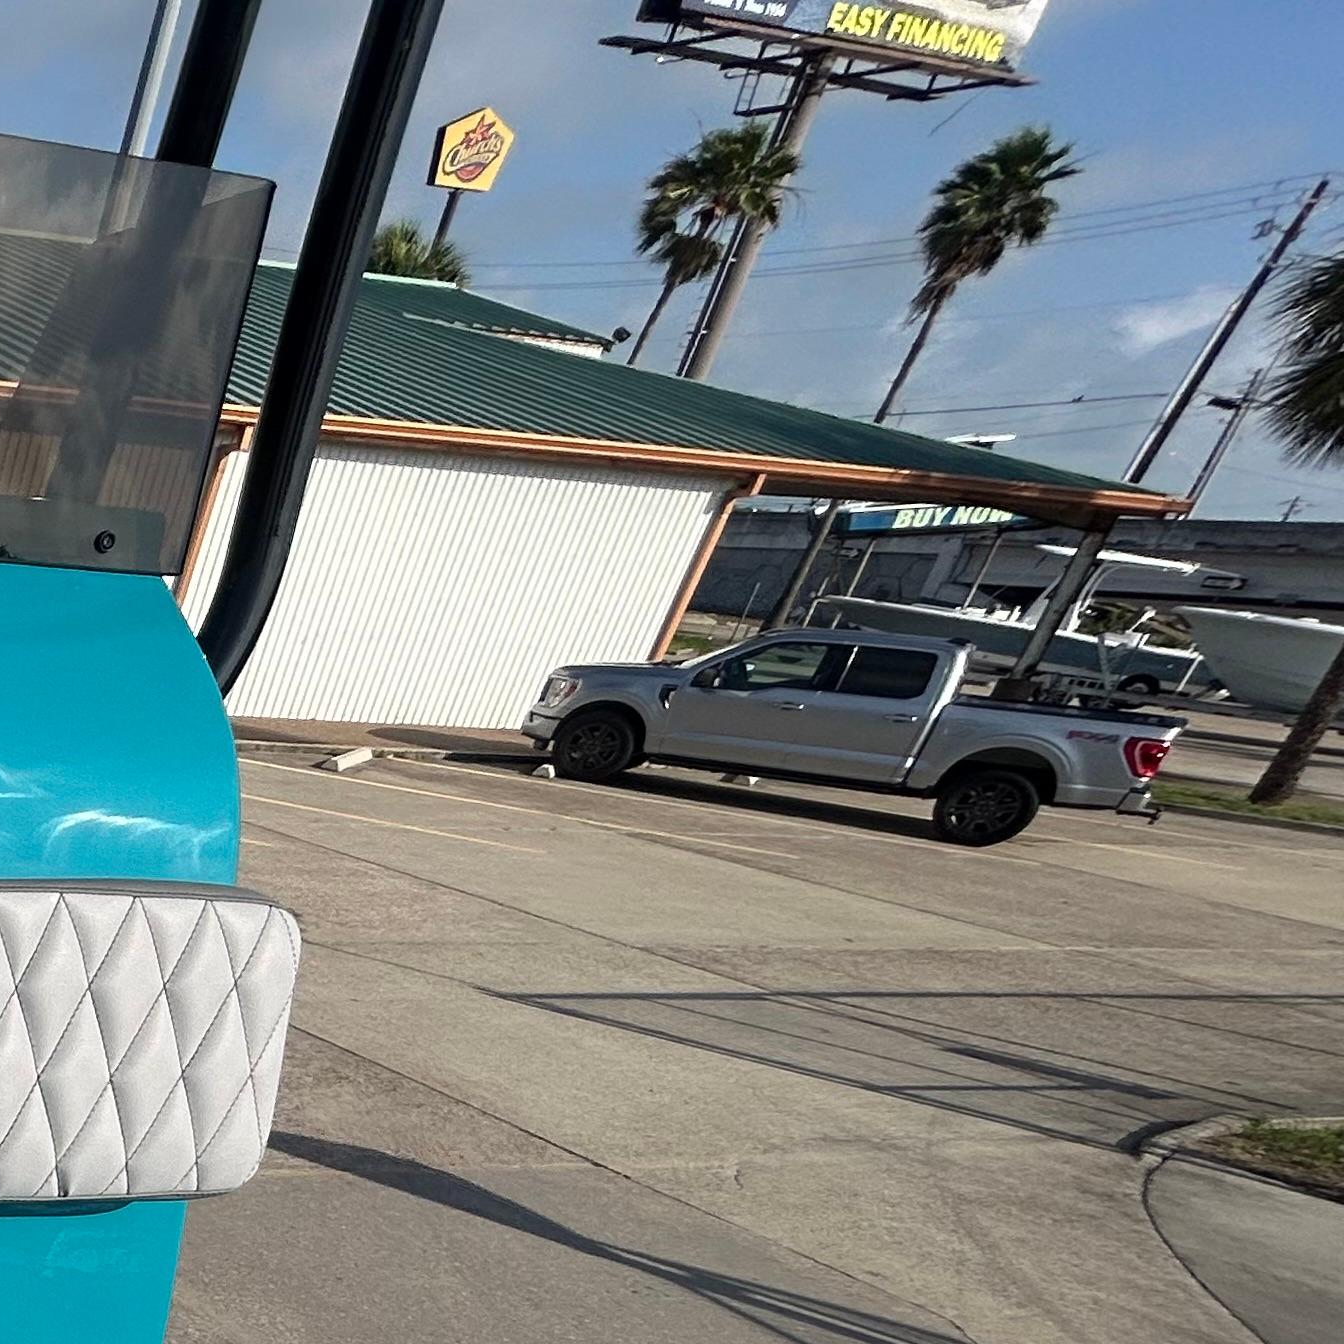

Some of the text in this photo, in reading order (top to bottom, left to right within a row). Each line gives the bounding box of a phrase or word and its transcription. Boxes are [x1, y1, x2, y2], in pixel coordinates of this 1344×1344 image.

[827, 2, 1005, 61] EASY FINANCING
[892, 506, 1013, 529] BUY NOW
